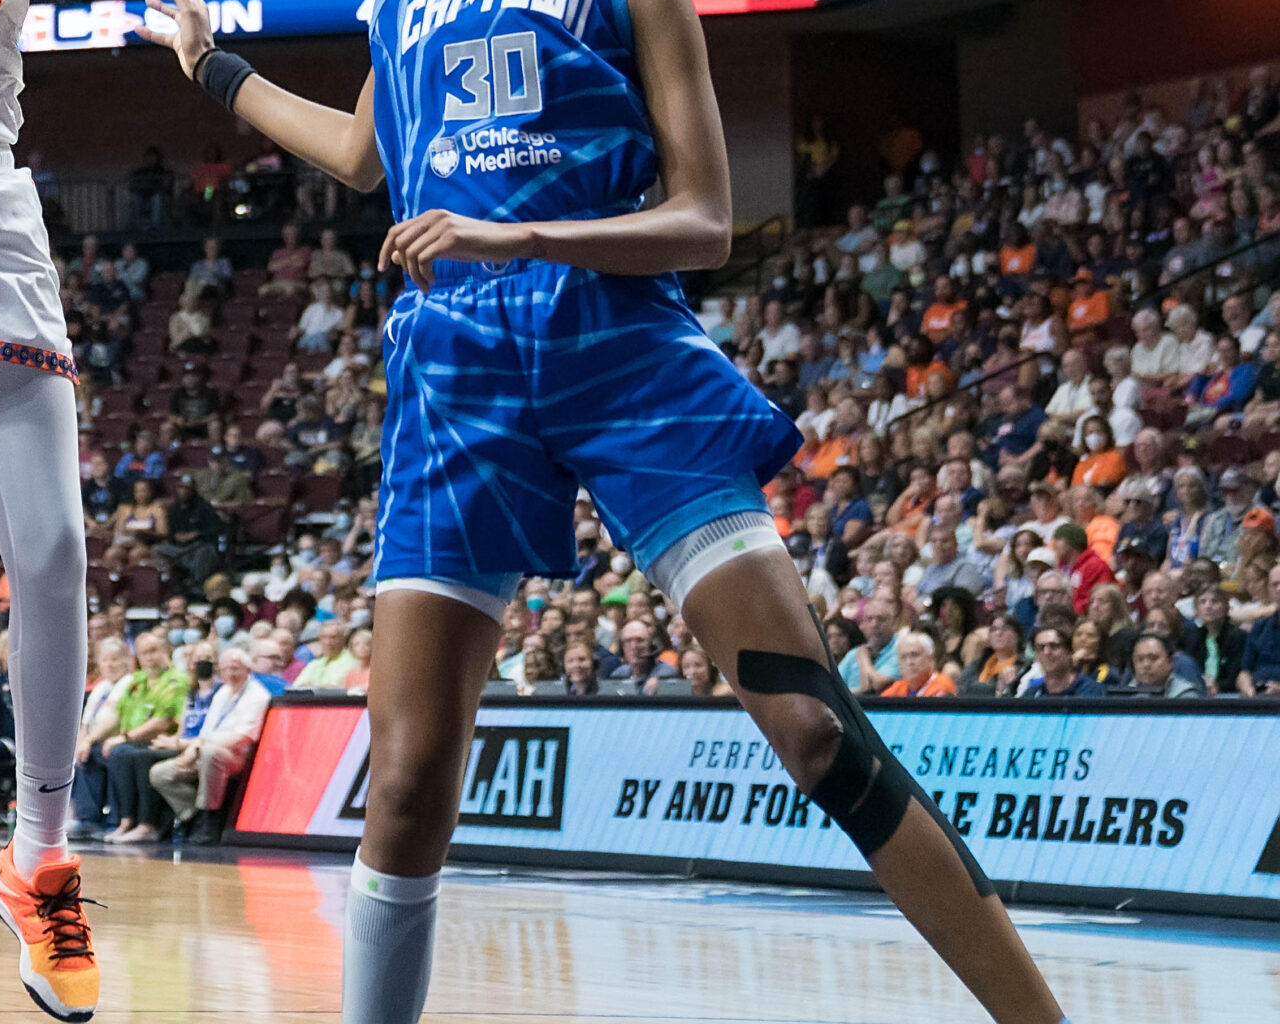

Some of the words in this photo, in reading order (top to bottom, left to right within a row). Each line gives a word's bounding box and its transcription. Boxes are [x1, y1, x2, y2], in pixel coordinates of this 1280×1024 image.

[443, 31, 543, 121] 30
[462, 126, 557, 152] UChicago
[464, 146, 562, 175] Medicine
[915, 745, 1093, 781] SNEAKERS
[614, 779, 660, 818] BY
[663, 780, 734, 824] AND
[987, 793, 1189, 848] BALLERS
